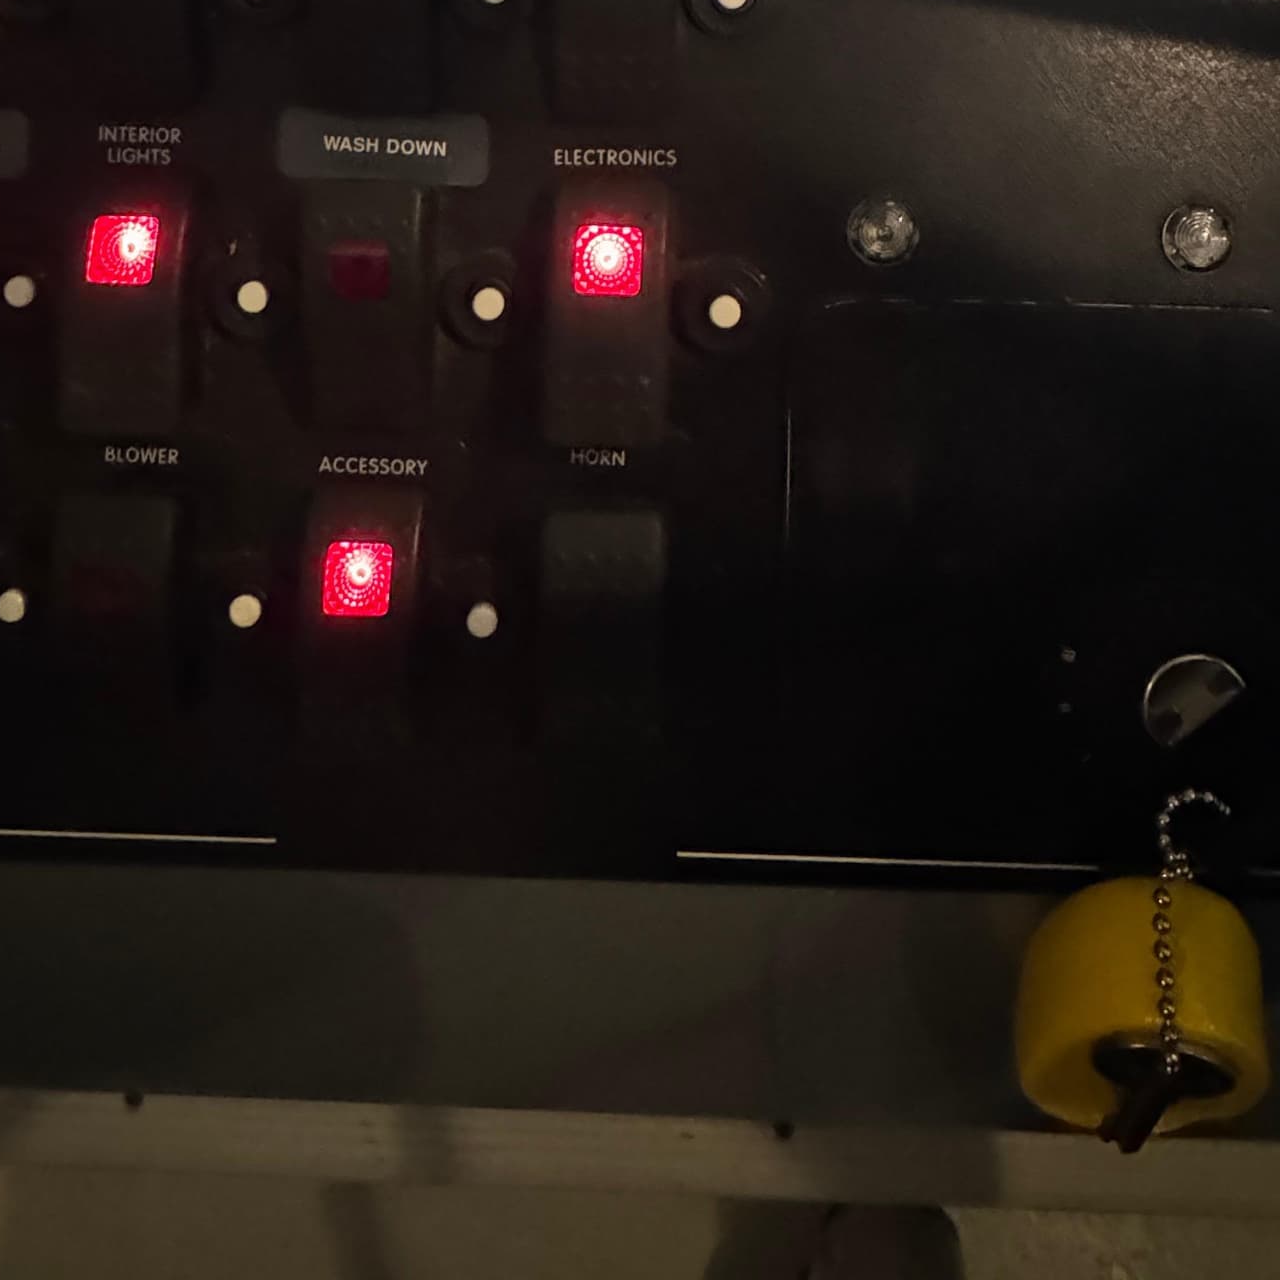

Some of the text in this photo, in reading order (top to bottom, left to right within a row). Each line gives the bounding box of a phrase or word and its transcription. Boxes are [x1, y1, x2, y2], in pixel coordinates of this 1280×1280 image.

[98, 125, 182, 144] INTERIOR
[323, 135, 447, 157] WASH DOWN
[107, 147, 171, 165] LIGHTS
[553, 148, 677, 167] ELECTRONICS
[104, 446, 179, 465] BLOWER
[569, 447, 626, 466] HORN
[319, 455, 428, 476] ACCESSORY
